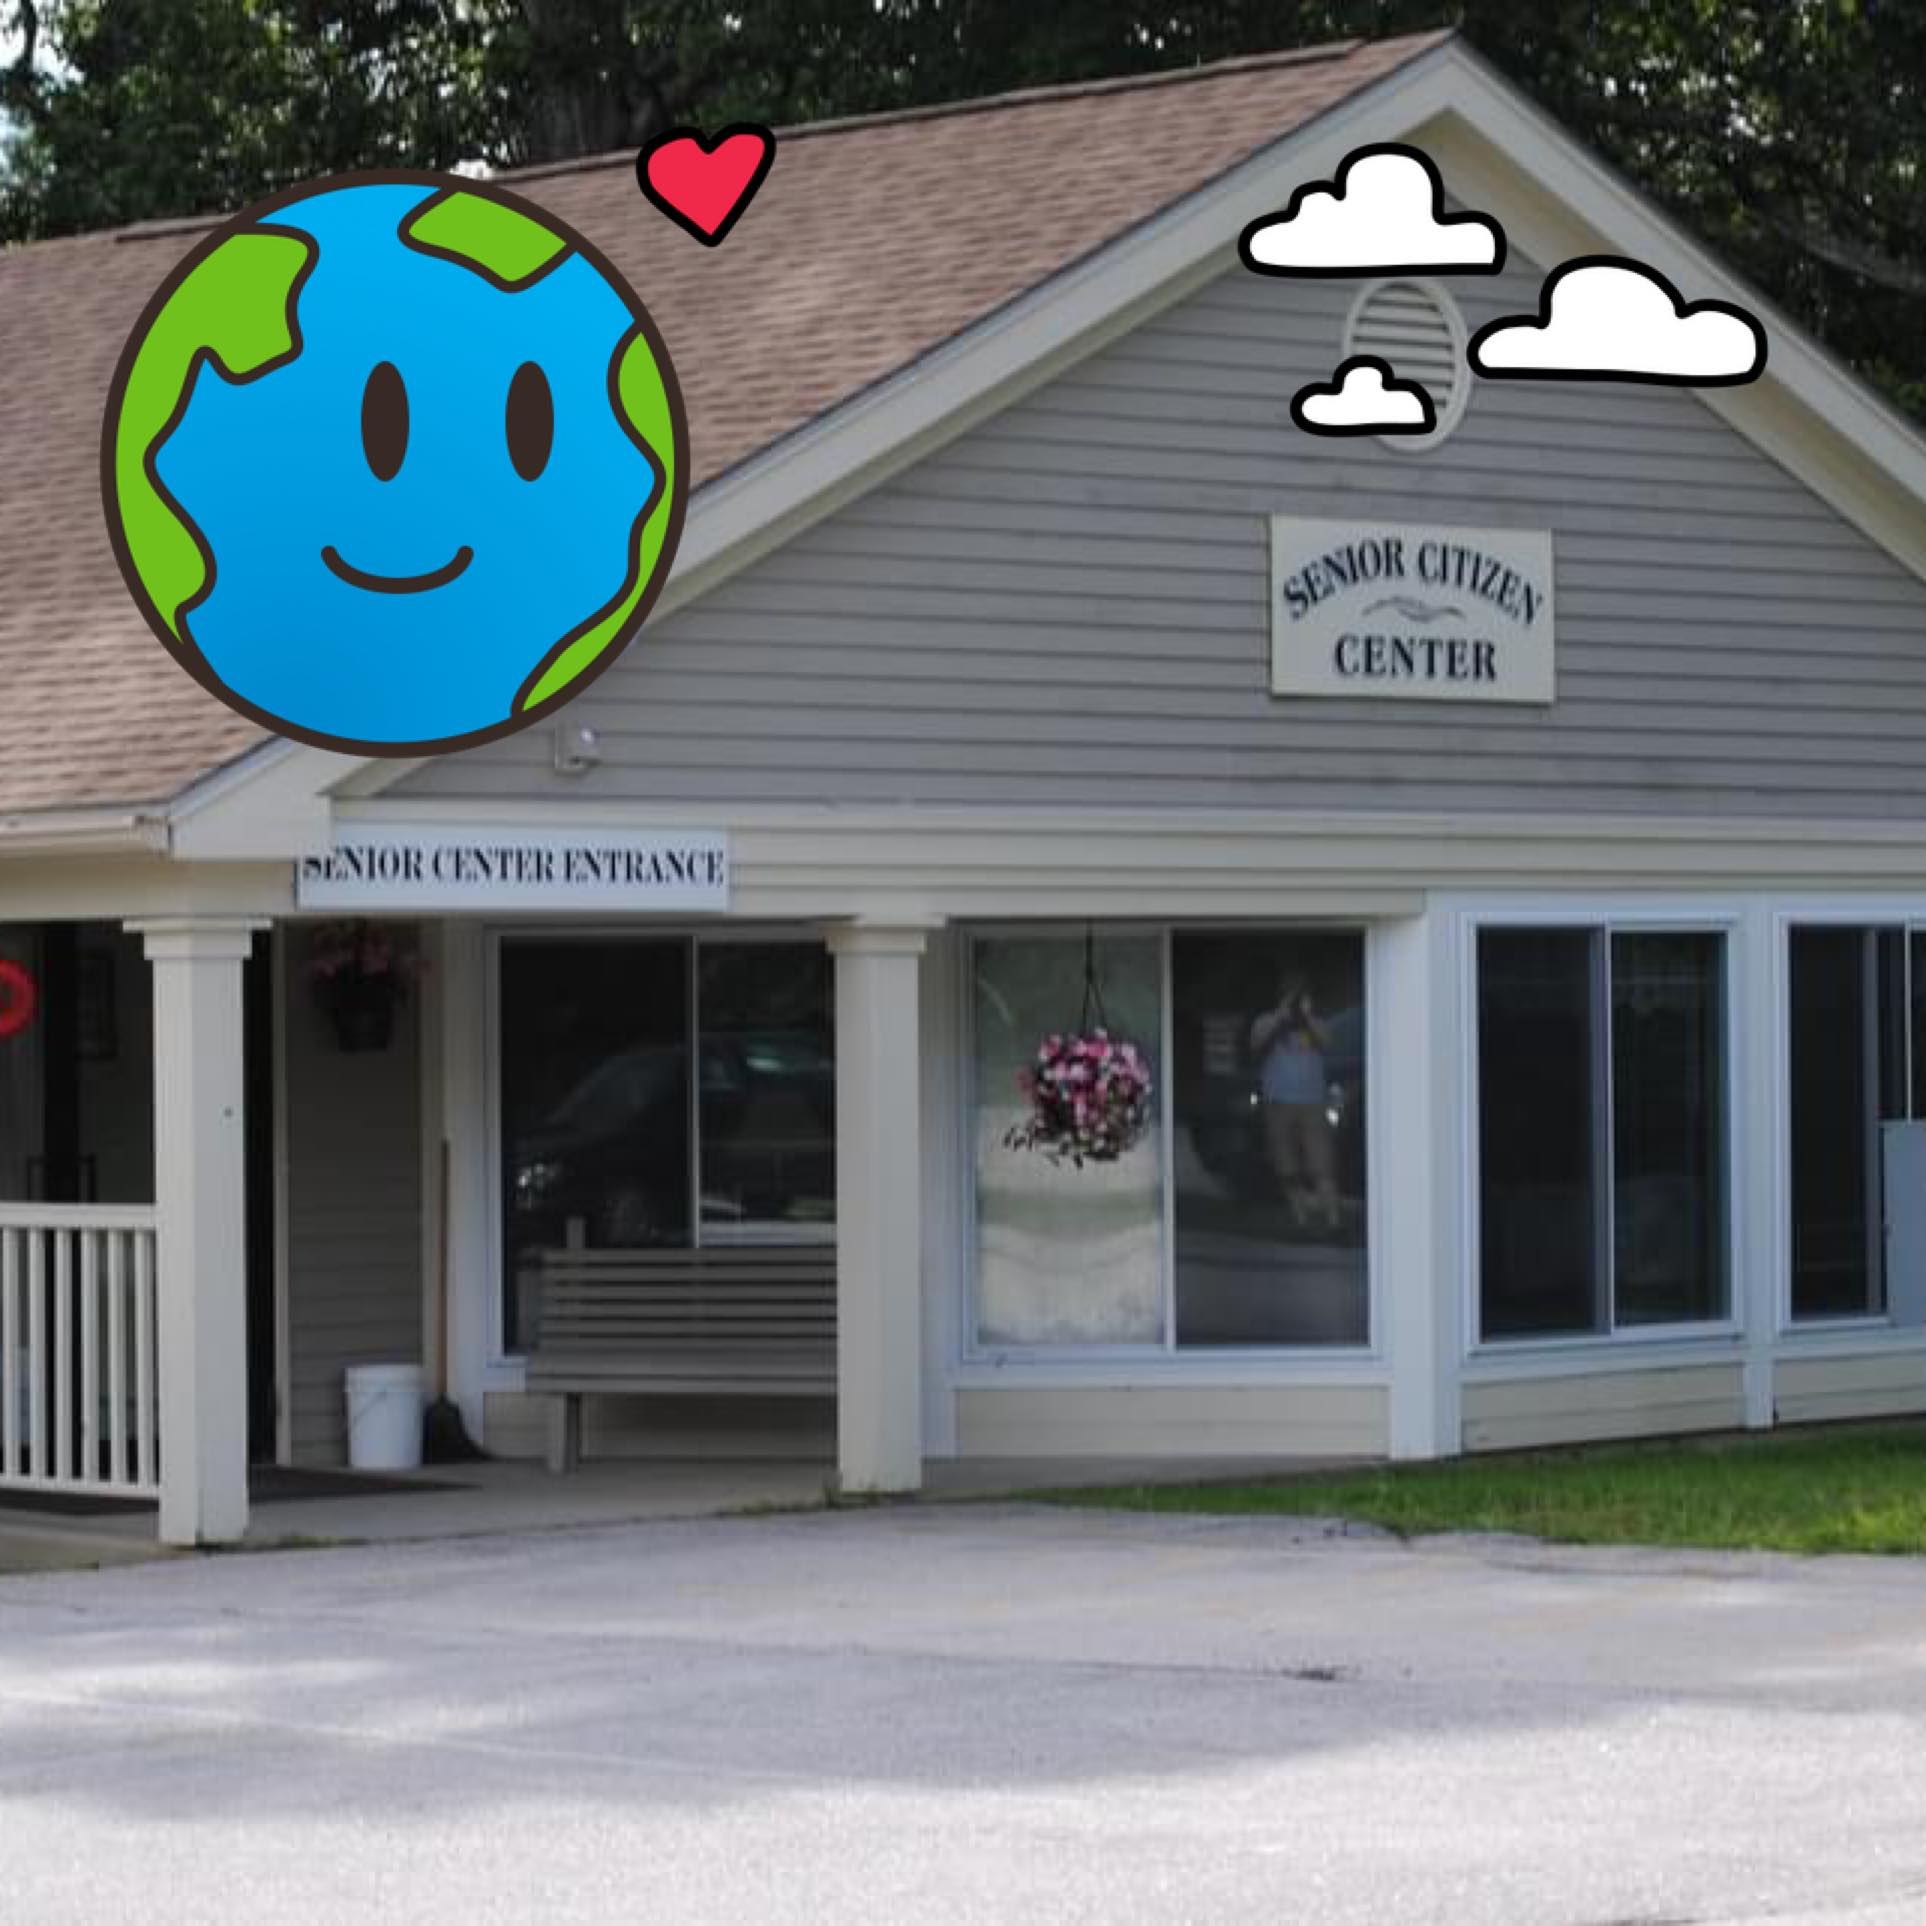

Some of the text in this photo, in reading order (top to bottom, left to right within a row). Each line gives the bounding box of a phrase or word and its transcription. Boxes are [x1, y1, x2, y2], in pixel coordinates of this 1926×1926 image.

[1283, 538, 1543, 625] SENIOR CITIZEN
[1334, 634, 1498, 681] CENTER
[432, 847, 554, 883] CENTER
[564, 848, 725, 886] ENTRANCE
